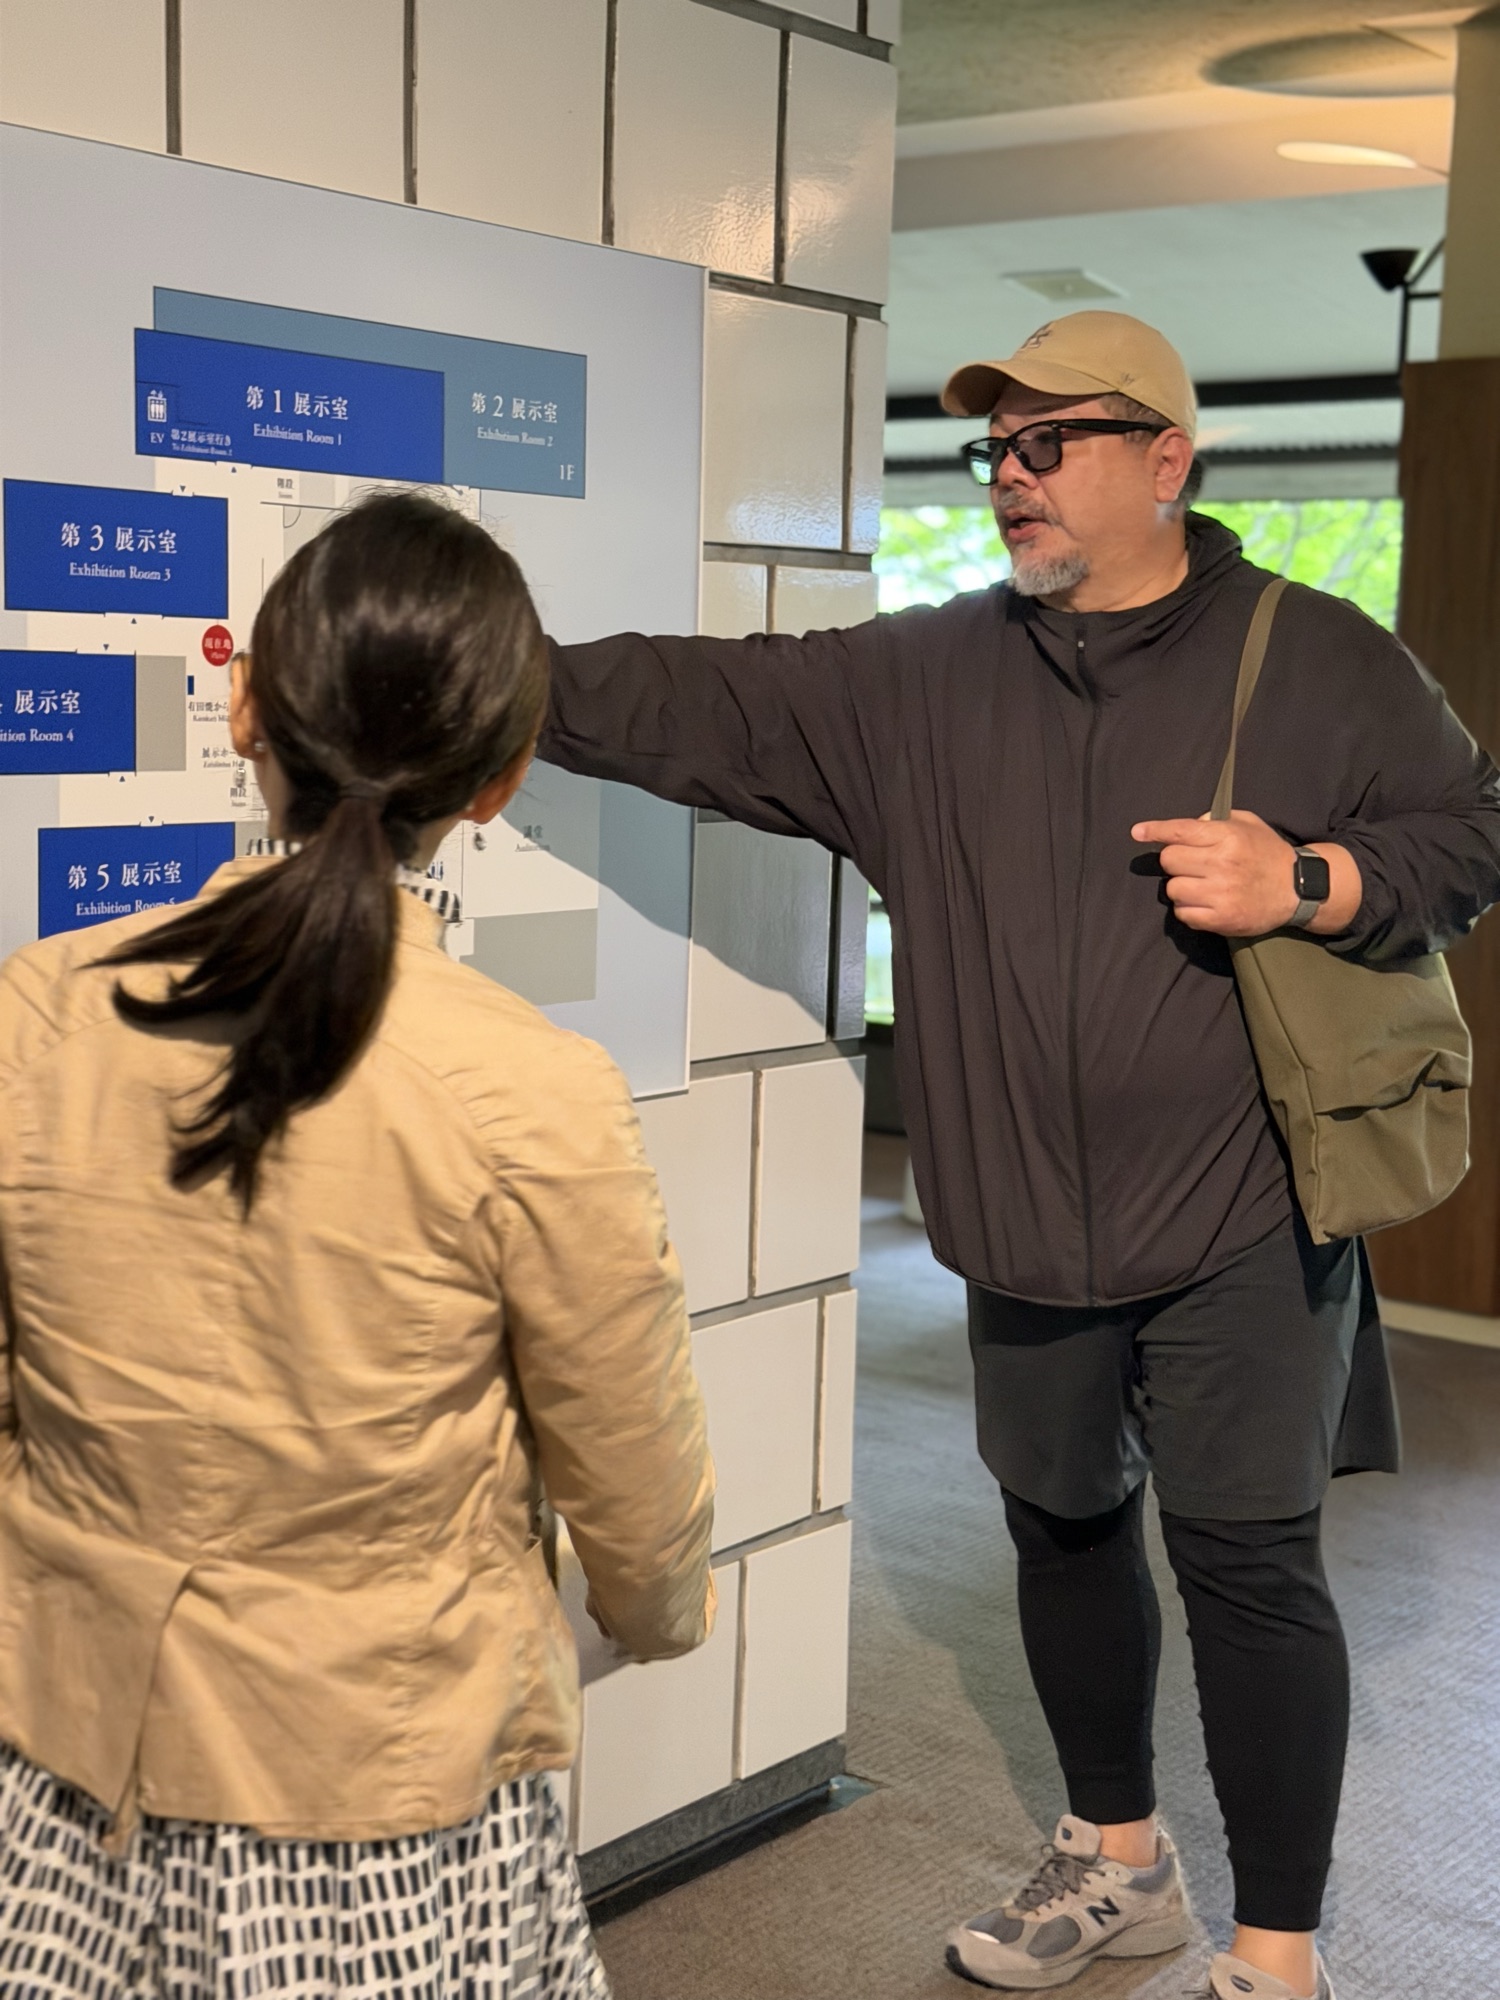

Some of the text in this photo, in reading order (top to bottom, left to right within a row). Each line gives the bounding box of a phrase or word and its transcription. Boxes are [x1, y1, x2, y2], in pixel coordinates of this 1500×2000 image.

[150, 431, 165, 444] EV
[253, 423, 343, 446] Exhibition Room 1
[546, 436, 554, 447] 2
[560, 464, 575, 480] 1F
[69, 561, 171, 582] Exhibition Room 3
[0, 689, 81, 715] 展示室
[29, 728, 64, 742] Room
[66, 727, 75, 742] 4
[76, 901, 132, 916] Exhibition
